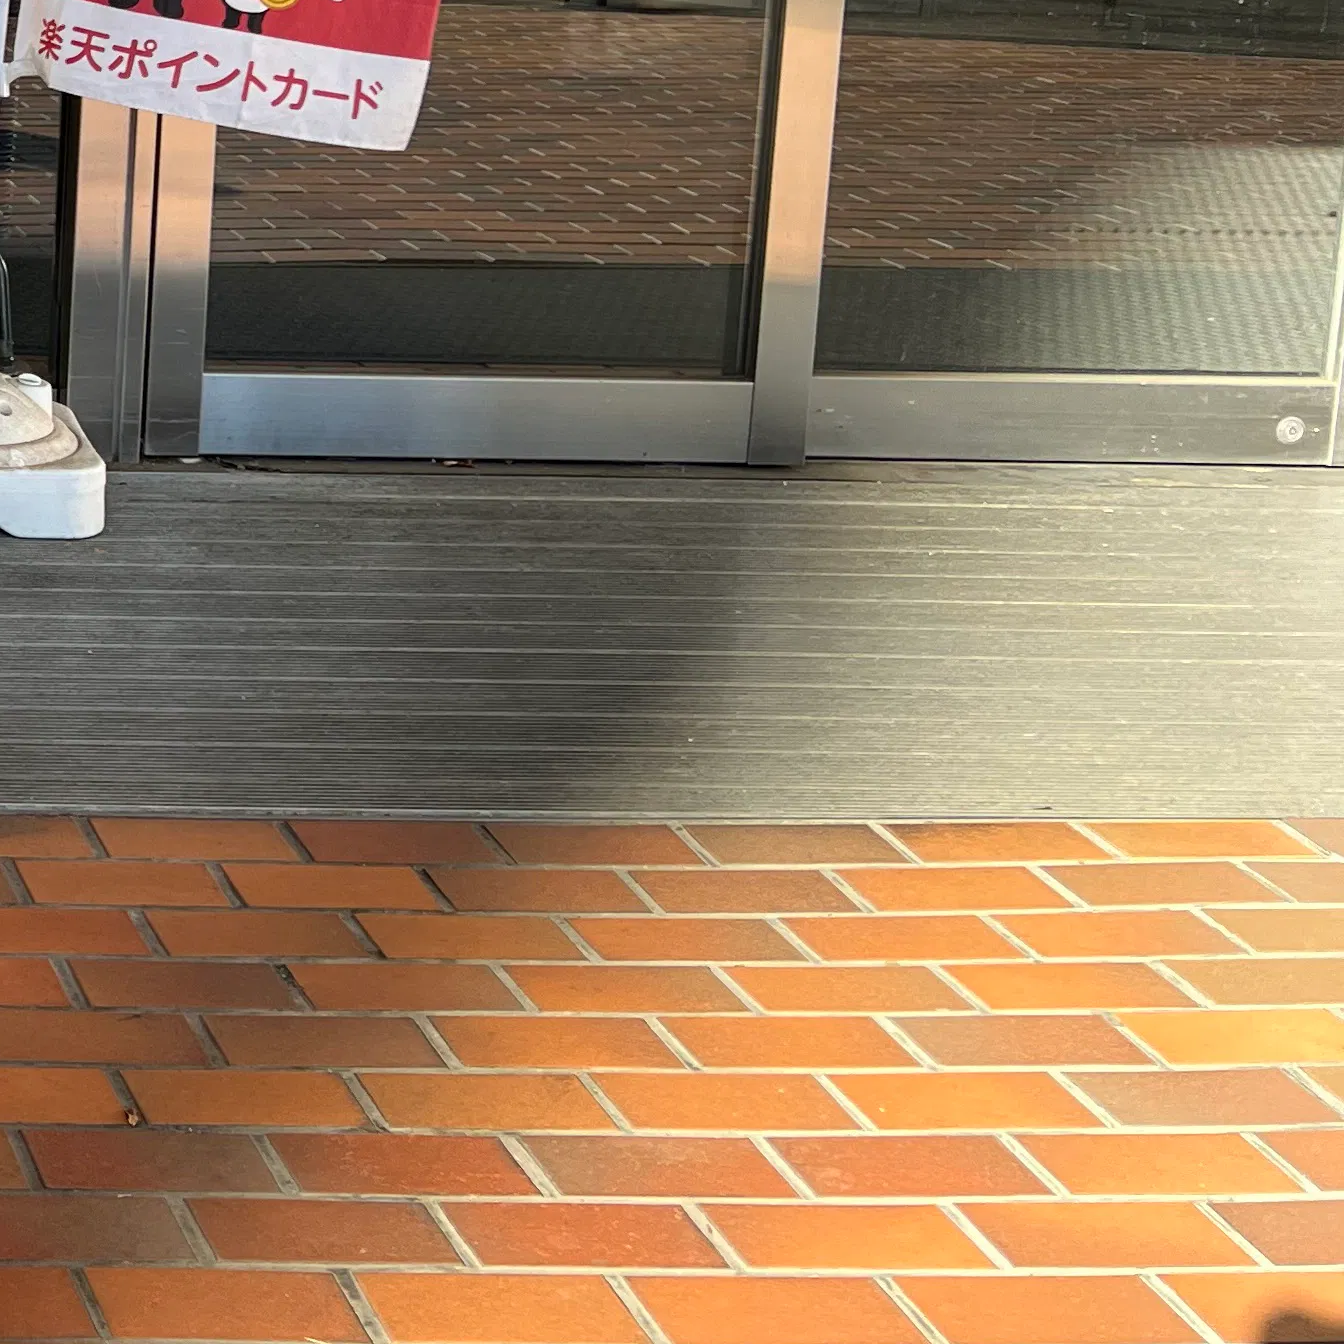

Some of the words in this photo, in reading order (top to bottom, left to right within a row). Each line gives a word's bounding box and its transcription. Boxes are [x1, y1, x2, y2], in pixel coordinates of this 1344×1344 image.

[37, 18, 383, 120] 楽天ポイントカード
